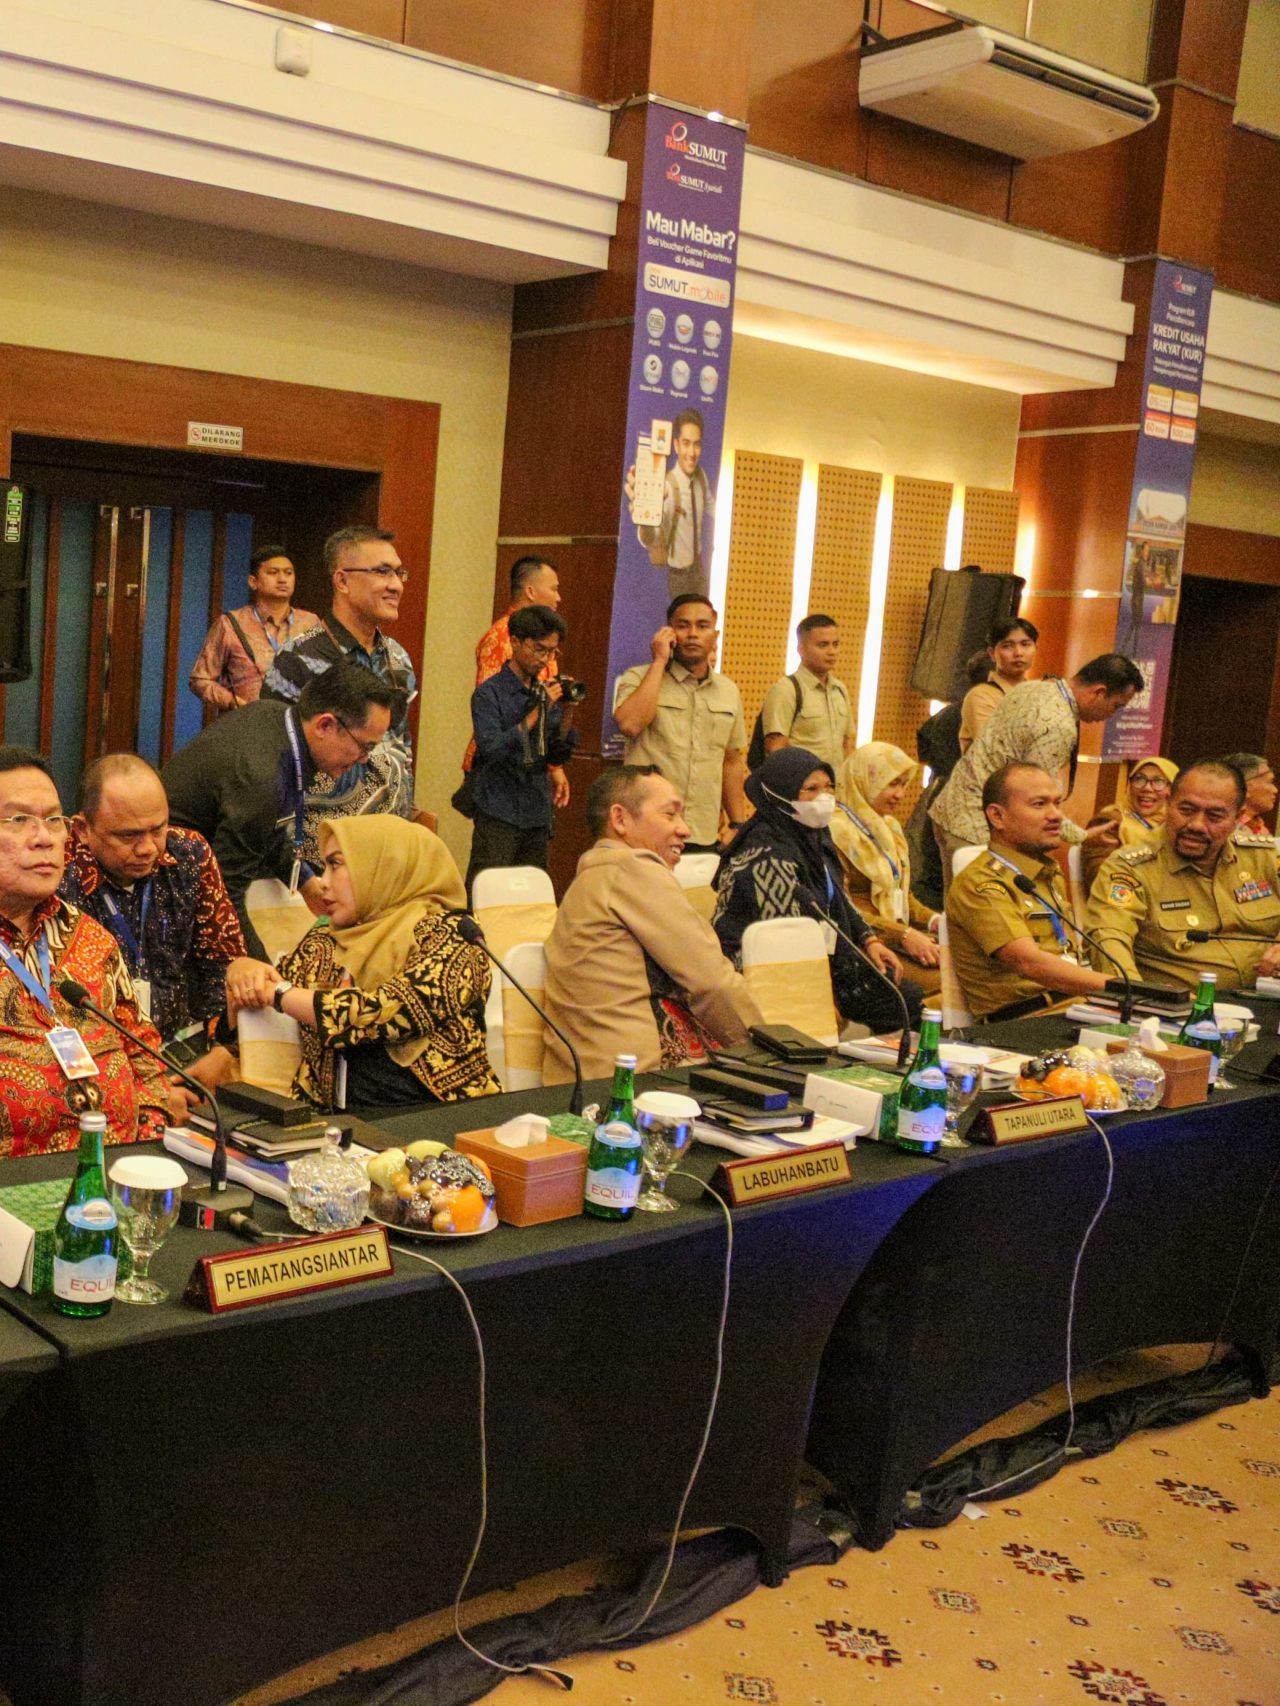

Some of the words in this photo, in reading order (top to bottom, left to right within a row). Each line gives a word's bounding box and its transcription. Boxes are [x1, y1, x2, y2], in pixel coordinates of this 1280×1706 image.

[688, 141, 728, 165] SUMUT
[680, 175, 704, 189] SUMUT
[646, 209, 679, 238] Mau
[680, 218, 736, 251] Mabar?
[660, 239, 684, 253] Voucher
[684, 244, 703, 257] Game
[649, 274, 689, 293] SUMUT
[690, 286, 726, 304] mobile
[1153, 322, 1180, 341] KREDIT
[1180, 330, 1205, 347] USAHA
[1153, 338, 1181, 356] RAKYAT
[1181, 347, 1202, 364] (KUR)
[202, 427, 241, 438] DILARANG
[202, 436, 240, 446] MEROKOK
[1005, 1111, 1047, 1131] TAPANULI
[1048, 1107, 1076, 1124] UTARA
[742, 1156, 839, 1191] LABUHANBATU
[224, 1243, 380, 1292] PEMATANGSIANTAR
